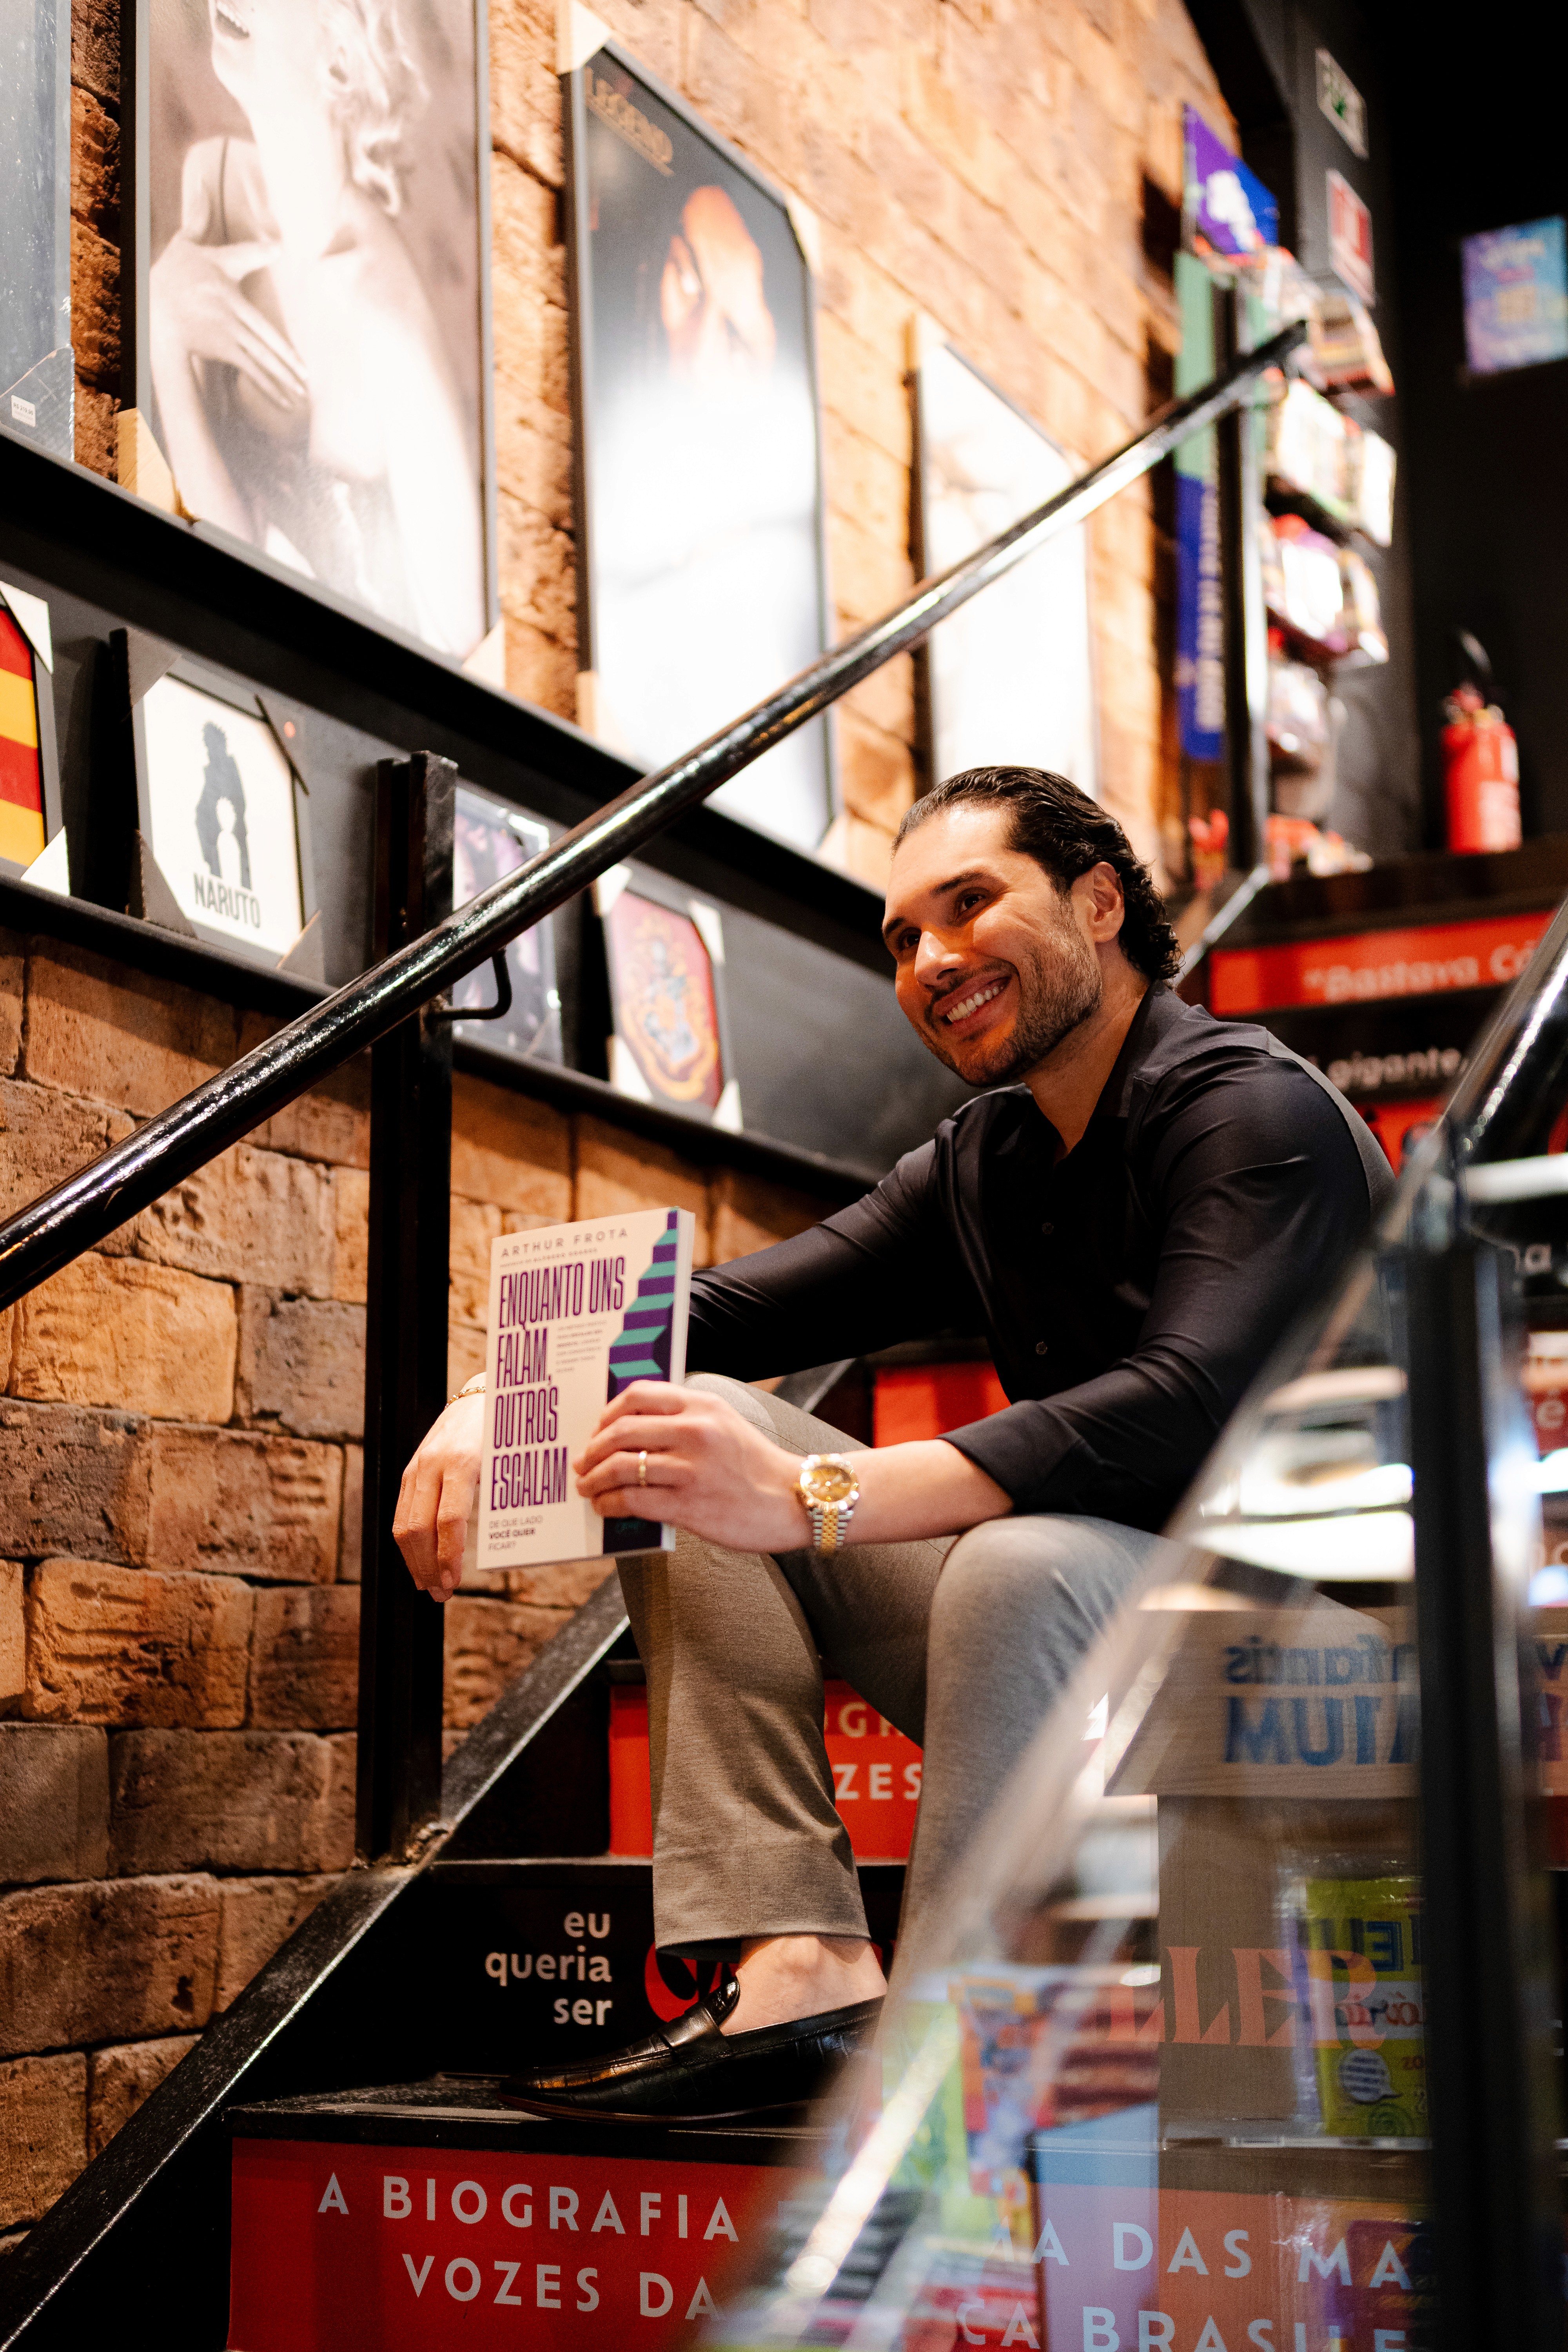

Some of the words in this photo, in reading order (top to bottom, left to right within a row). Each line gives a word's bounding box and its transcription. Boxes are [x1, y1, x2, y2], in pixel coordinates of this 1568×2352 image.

[193, 872, 261, 929] NARUTO
[501, 1238, 564, 1257] ARTHUR
[573, 1228, 627, 1245] FROTA
[498, 1262, 584, 1330] ENQUANTO
[589, 1256, 626, 1314] UNS
[496, 1327, 552, 1389] FALAM,
[494, 1386, 558, 1449] OUTROS
[491, 1446, 567, 1510] ESCALAM
[489, 1520, 499, 1529] DE
[501, 1517, 517, 1527] QUE
[520, 1514, 544, 1525] LADO
[564, 1911, 611, 1938] eu
[485, 1944, 613, 1987] queria
[554, 1998, 613, 2026] ser
[318, 2172, 350, 2215] A
[383, 2175, 739, 2242] BIOGRAFIA
[1112, 2221, 1253, 2279] DAS
[402, 2254, 600, 2313] VOZES
[639, 2272, 720, 2321] DA
